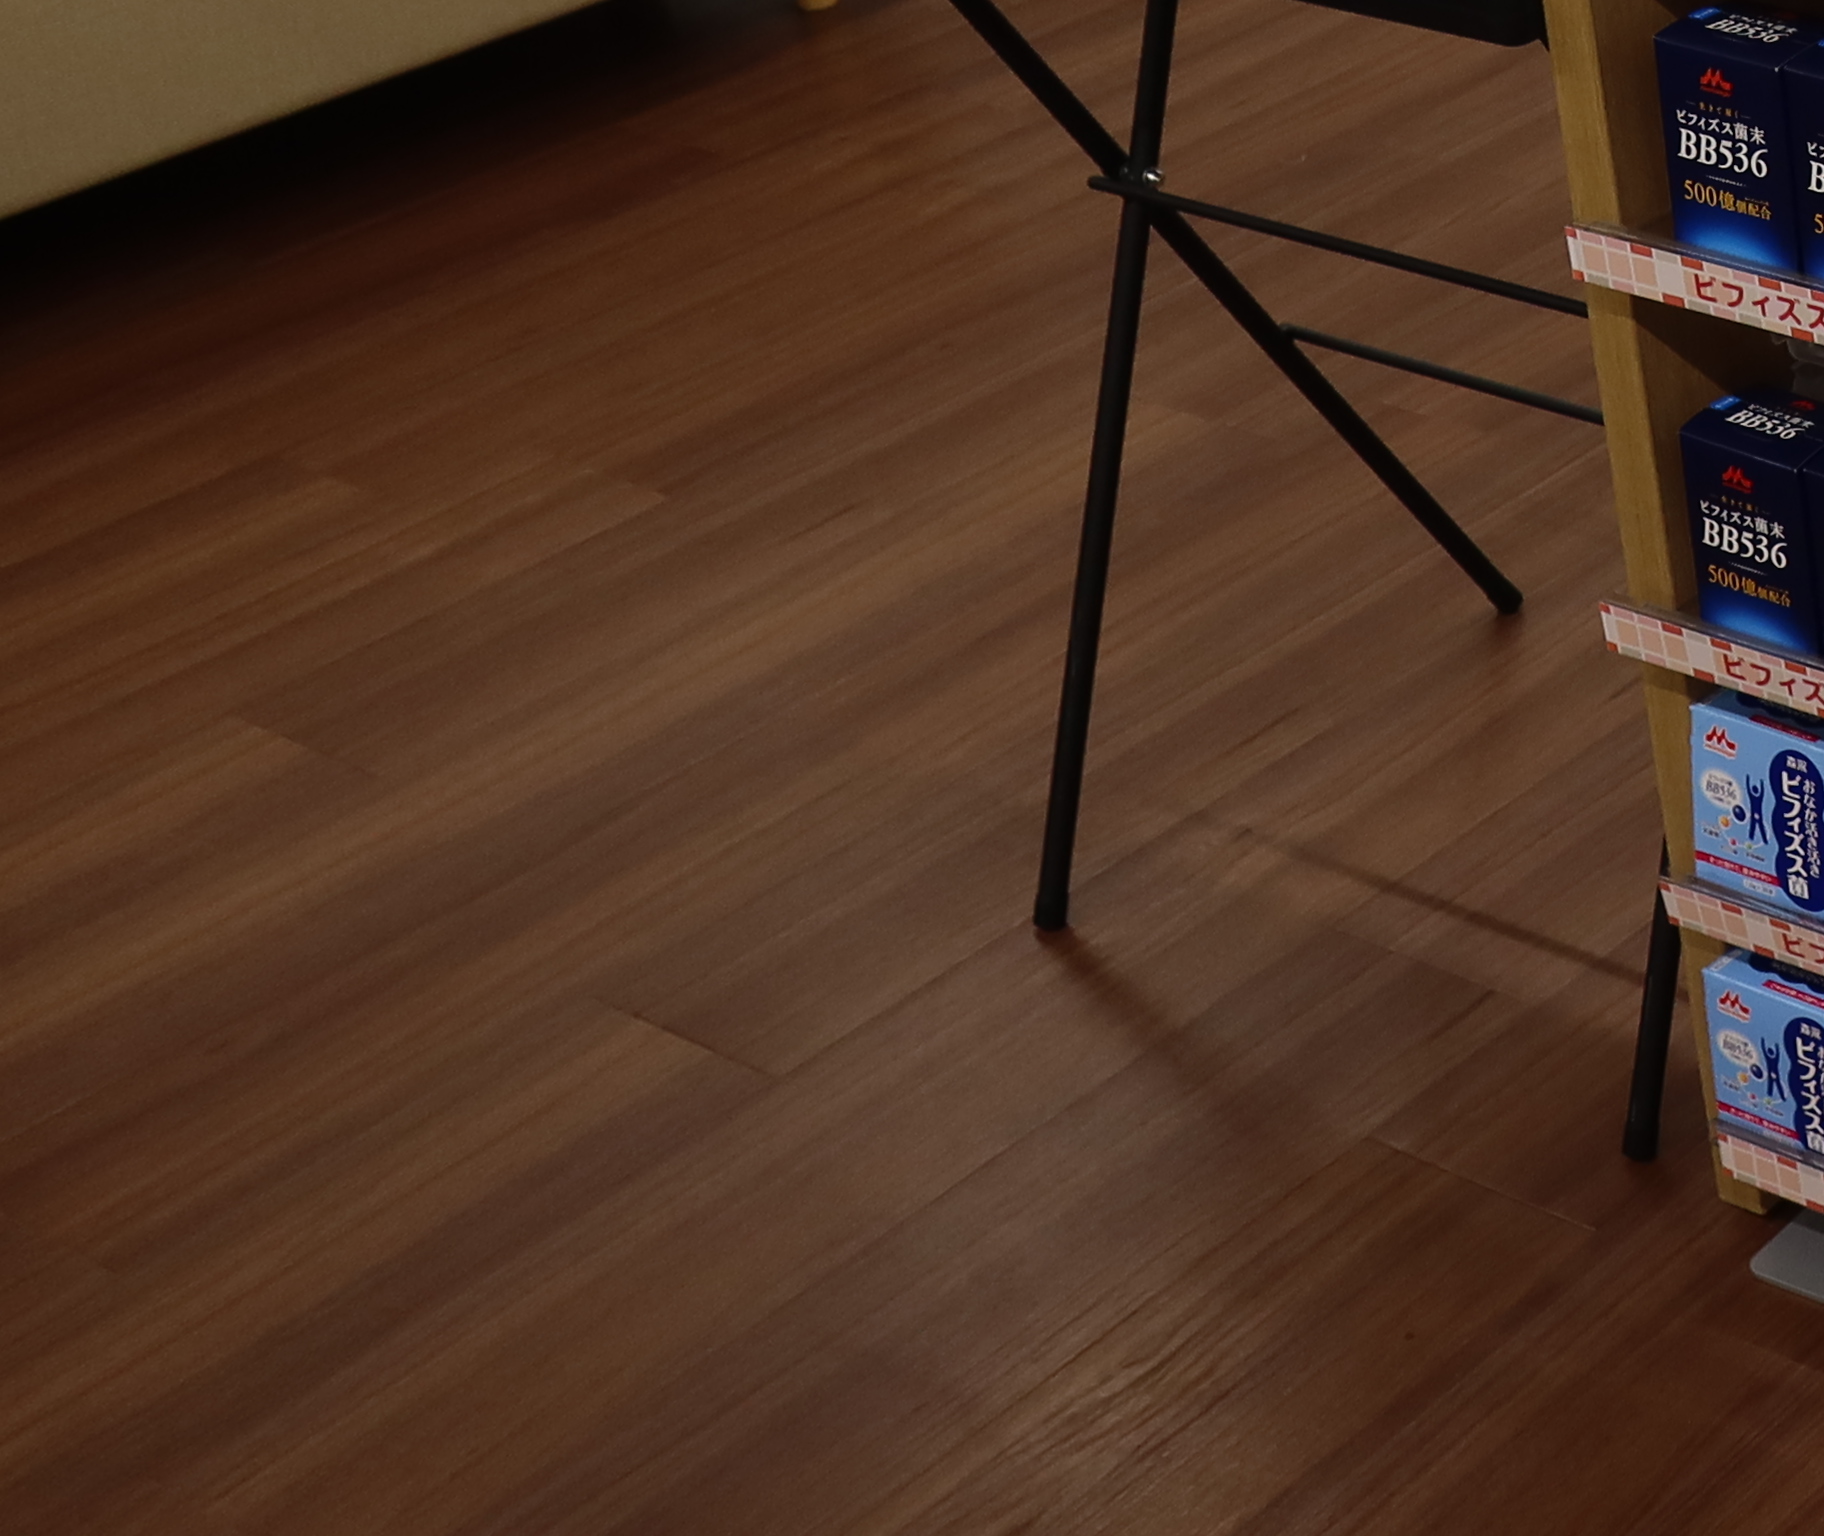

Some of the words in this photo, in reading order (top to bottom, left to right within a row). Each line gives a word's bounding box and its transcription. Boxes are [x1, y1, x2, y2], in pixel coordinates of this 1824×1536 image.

[1675, 108, 1766, 146] ビフィズス菌末
[1677, 129, 1768, 179] BB536
[1684, 180, 1772, 220] 500億個配合
[1702, 519, 1787, 568] BB536
[1708, 565, 1792, 607] 500億個配合
[1781, 771, 1809, 901] ビフィズス菌
[1802, 779, 1820, 879] おなか活き活き
